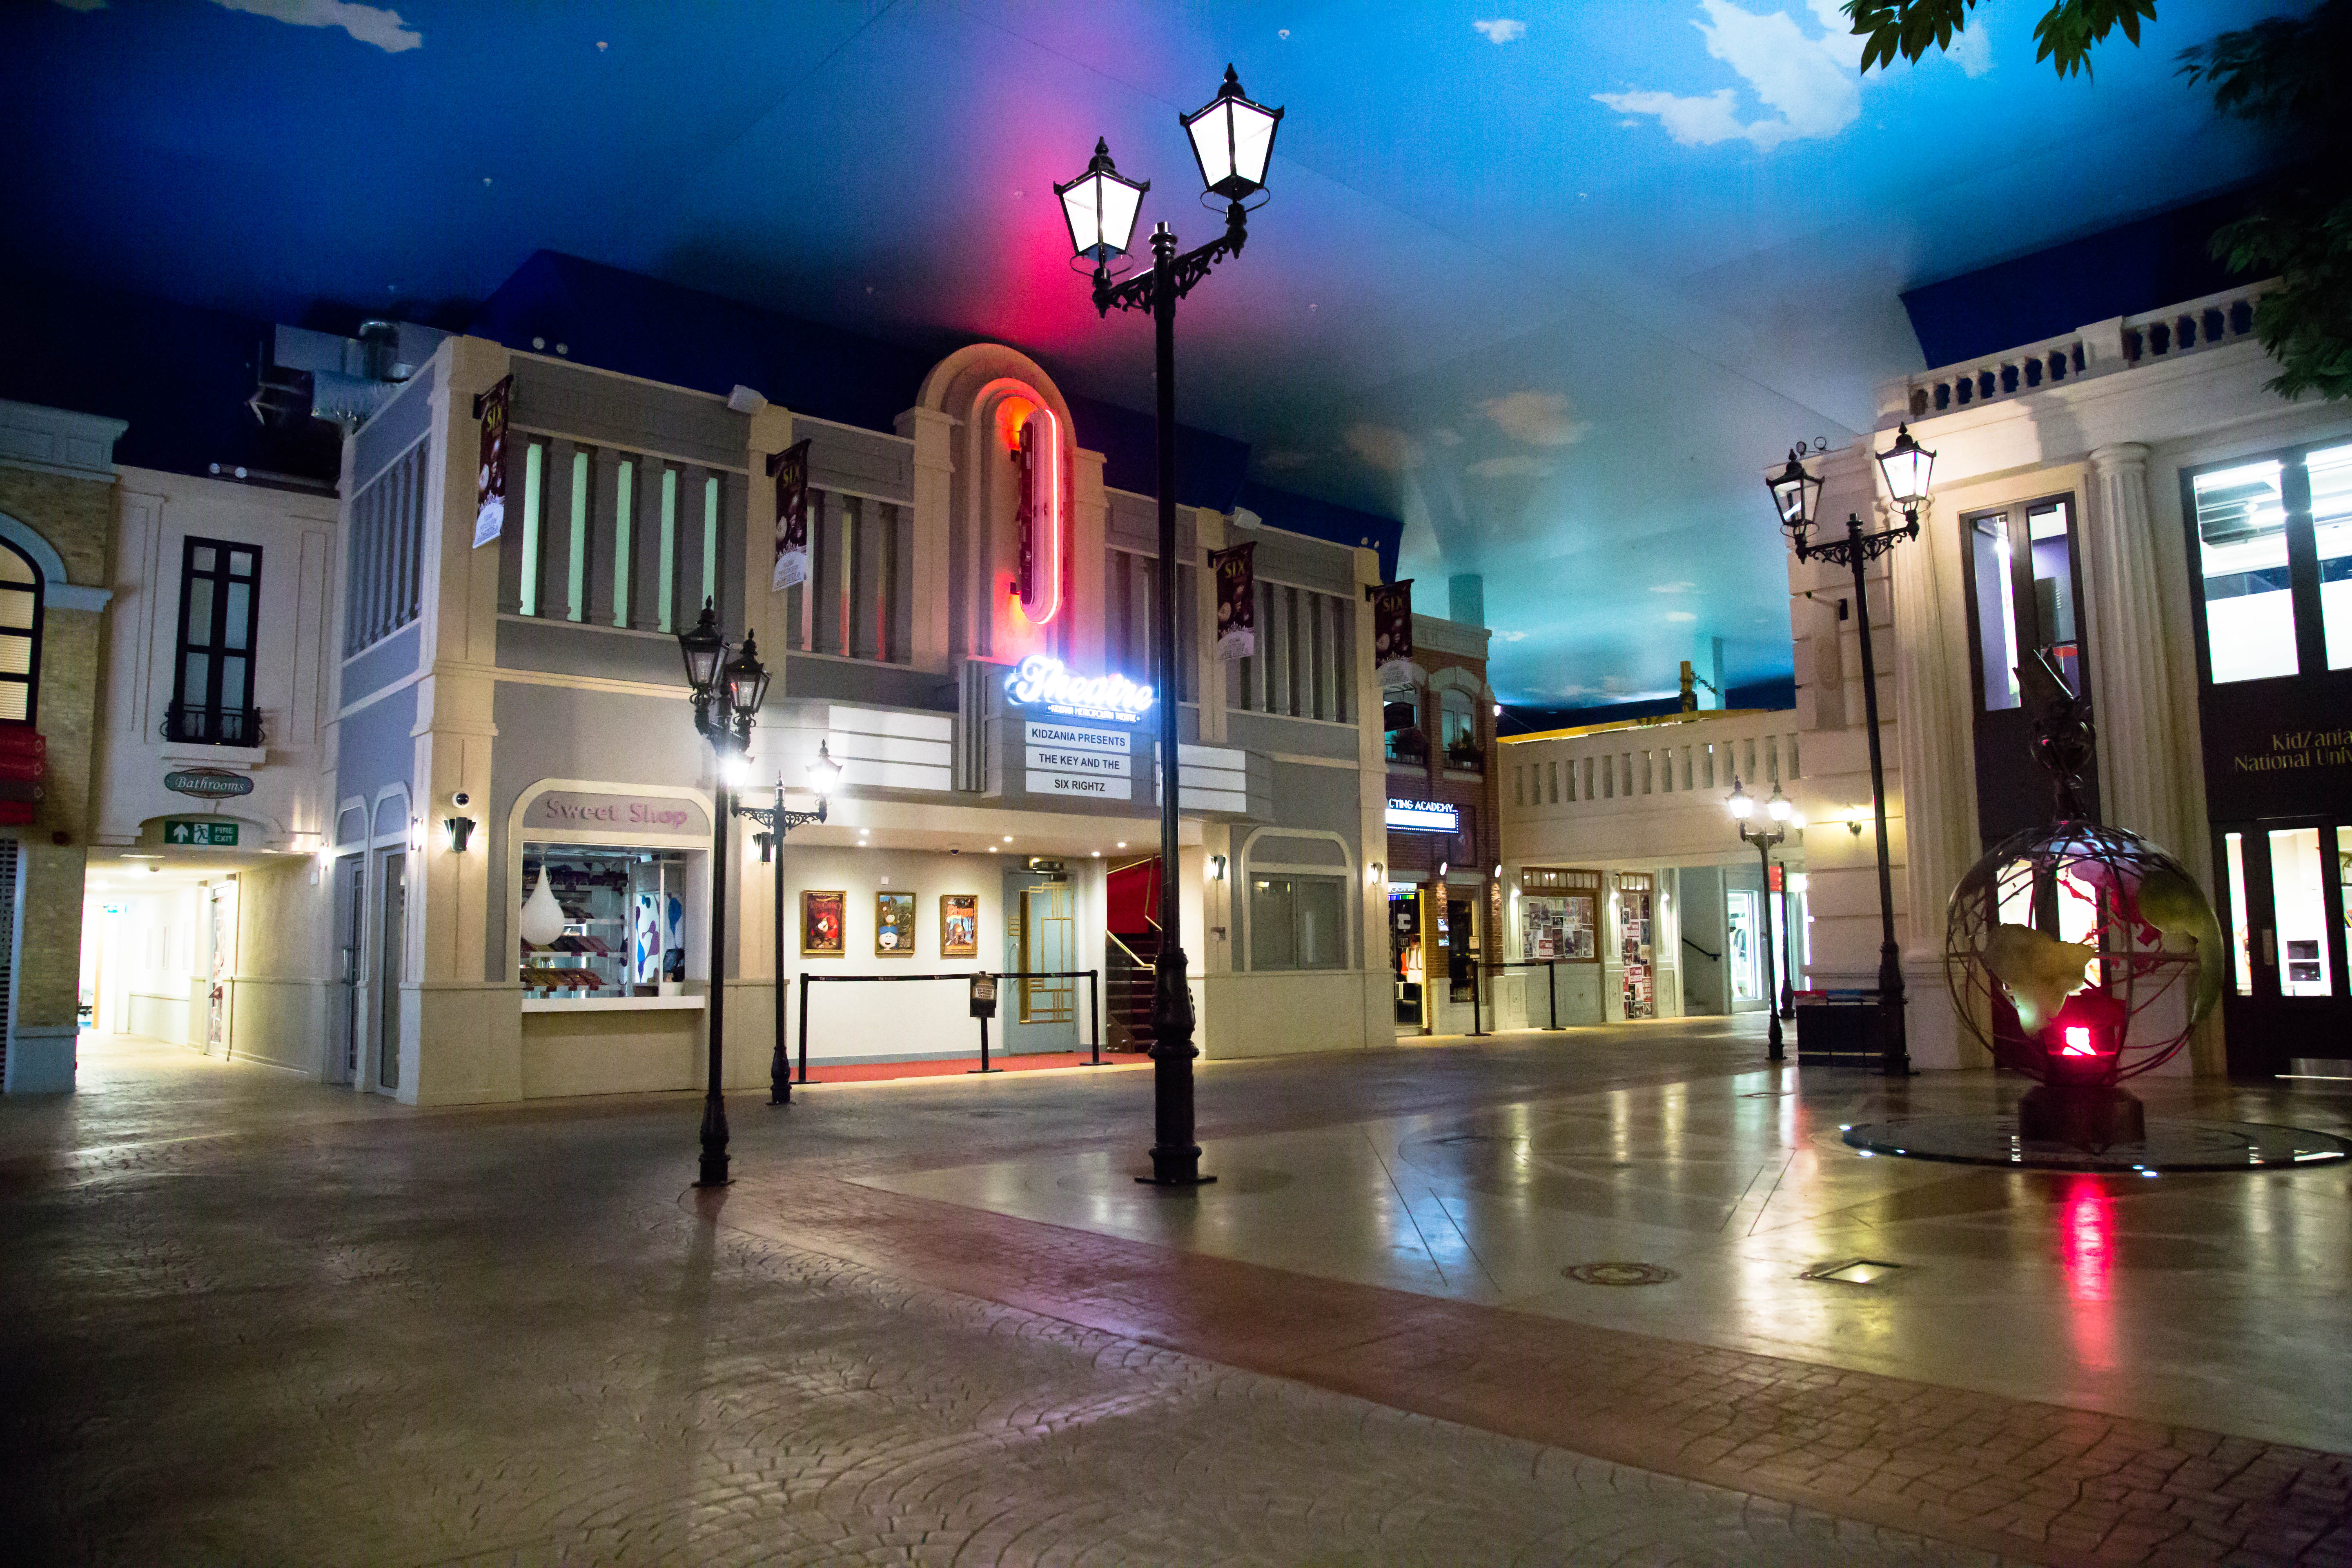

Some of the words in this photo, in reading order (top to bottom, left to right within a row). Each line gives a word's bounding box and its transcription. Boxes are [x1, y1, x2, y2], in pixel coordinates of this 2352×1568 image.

[487, 404, 503, 432] SIX
[1225, 560, 1245, 578] SIX
[1383, 596, 1403, 611] SIX
[1016, 654, 1153, 711] Theatre
[1032, 728, 1076, 742] KIDZANIA
[1078, 733, 1125, 746] PRESENTS
[1039, 753, 1058, 764] THE
[1060, 755, 1078, 766] KEY
[1081, 758, 1100, 768] AND
[1102, 760, 1120, 769] THE
[2234, 751, 2310, 772] National
[175, 777, 245, 791] Bathrooms
[1055, 779, 1069, 789] SIX
[1072, 781, 1105, 792] RIGHTZ
[546, 798, 618, 822] Sweet
[630, 802, 687, 830] Shop
[1388, 798, 1414, 809] CTING
[1415, 801, 1453, 813] ACADEMY
